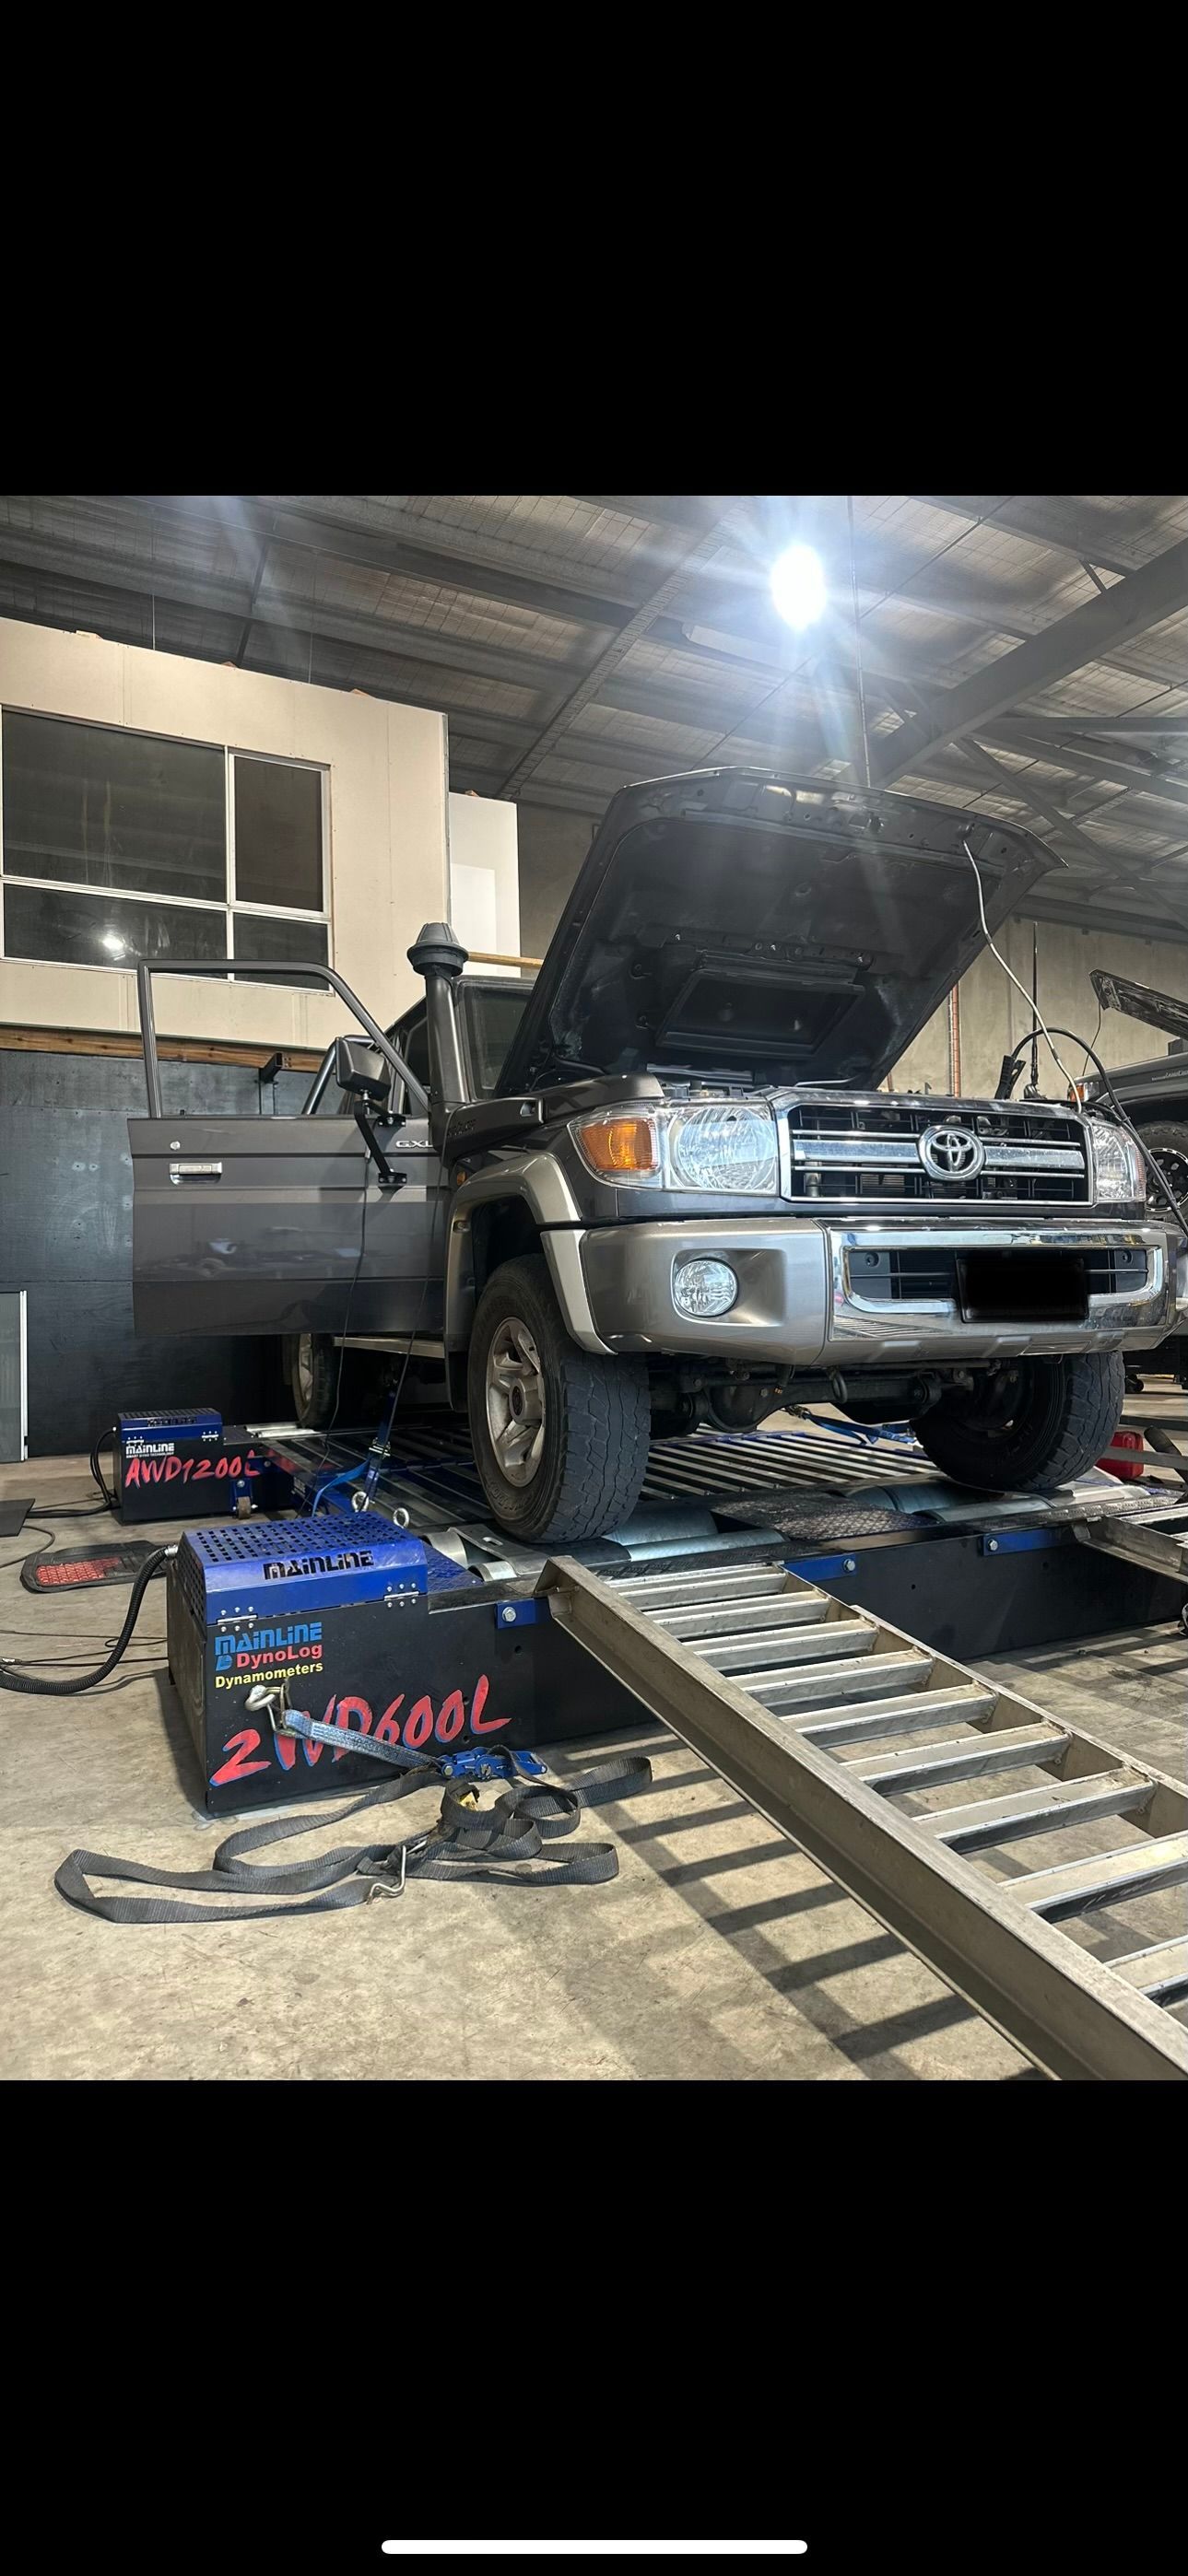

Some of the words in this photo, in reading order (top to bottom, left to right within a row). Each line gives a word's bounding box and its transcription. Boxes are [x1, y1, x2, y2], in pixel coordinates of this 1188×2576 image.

[395, 1140, 433, 1148] GXL
[124, 1449, 261, 1489] AWD1200L
[236, 1645, 323, 1669] DynoLog
[215, 1662, 323, 1689] Dynamometers
